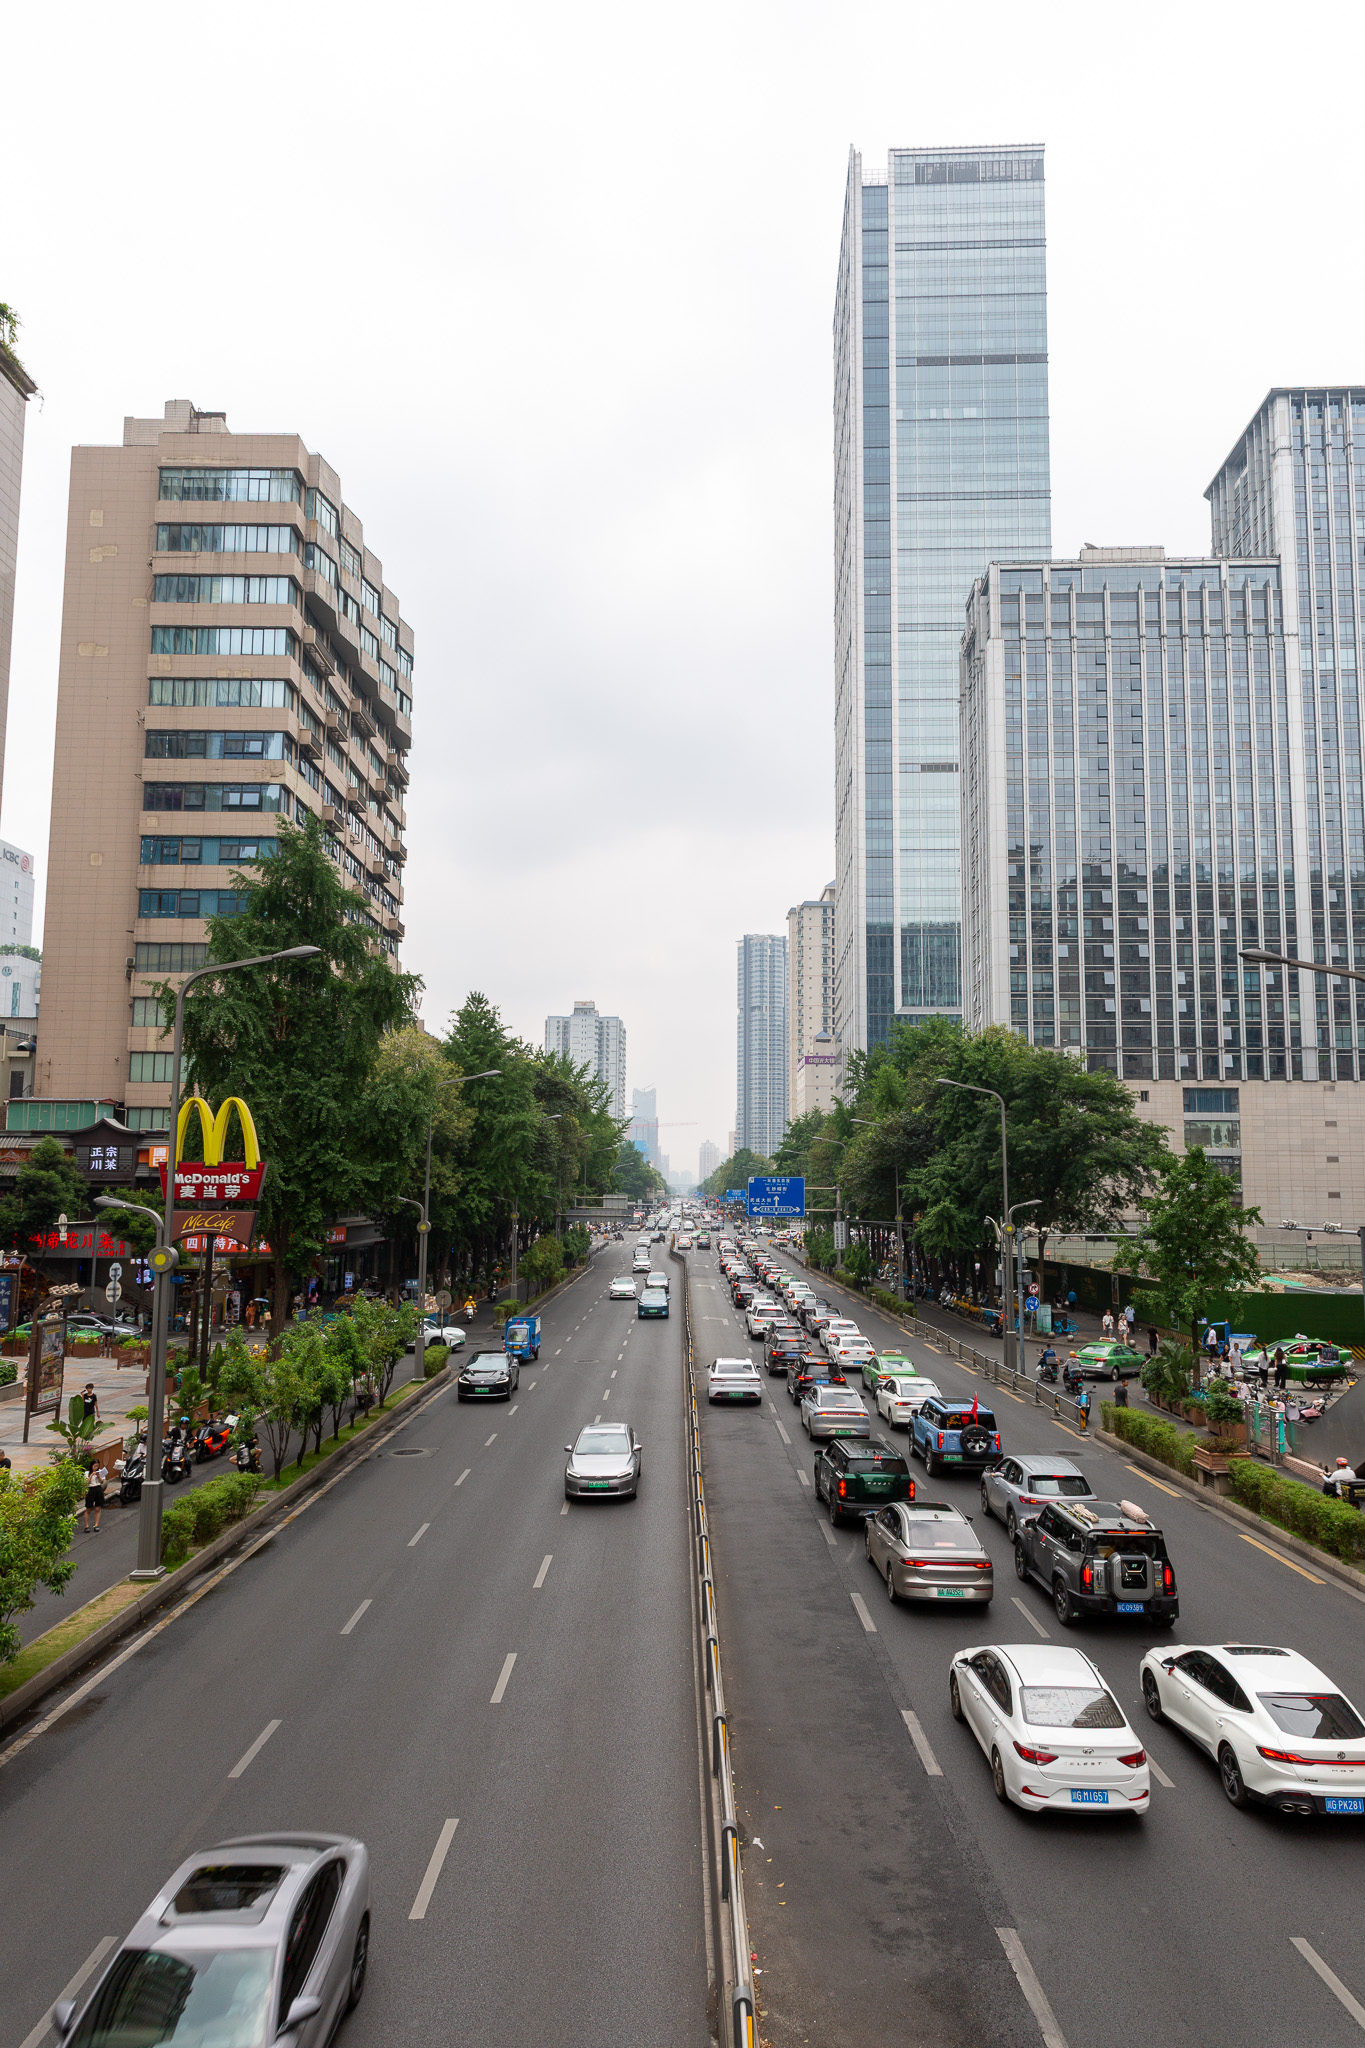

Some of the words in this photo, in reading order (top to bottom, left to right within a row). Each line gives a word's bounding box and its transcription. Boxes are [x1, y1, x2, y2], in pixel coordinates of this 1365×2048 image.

[3, 848, 19, 865] ICBC
[90, 1146, 118, 1157] 正宗
[90, 1158, 118, 1170] 川菜
[174, 1173, 250, 1184] McDonald's
[180, 1185, 241, 1198] 麦当劳
[181, 1213, 236, 1233] McCafé
